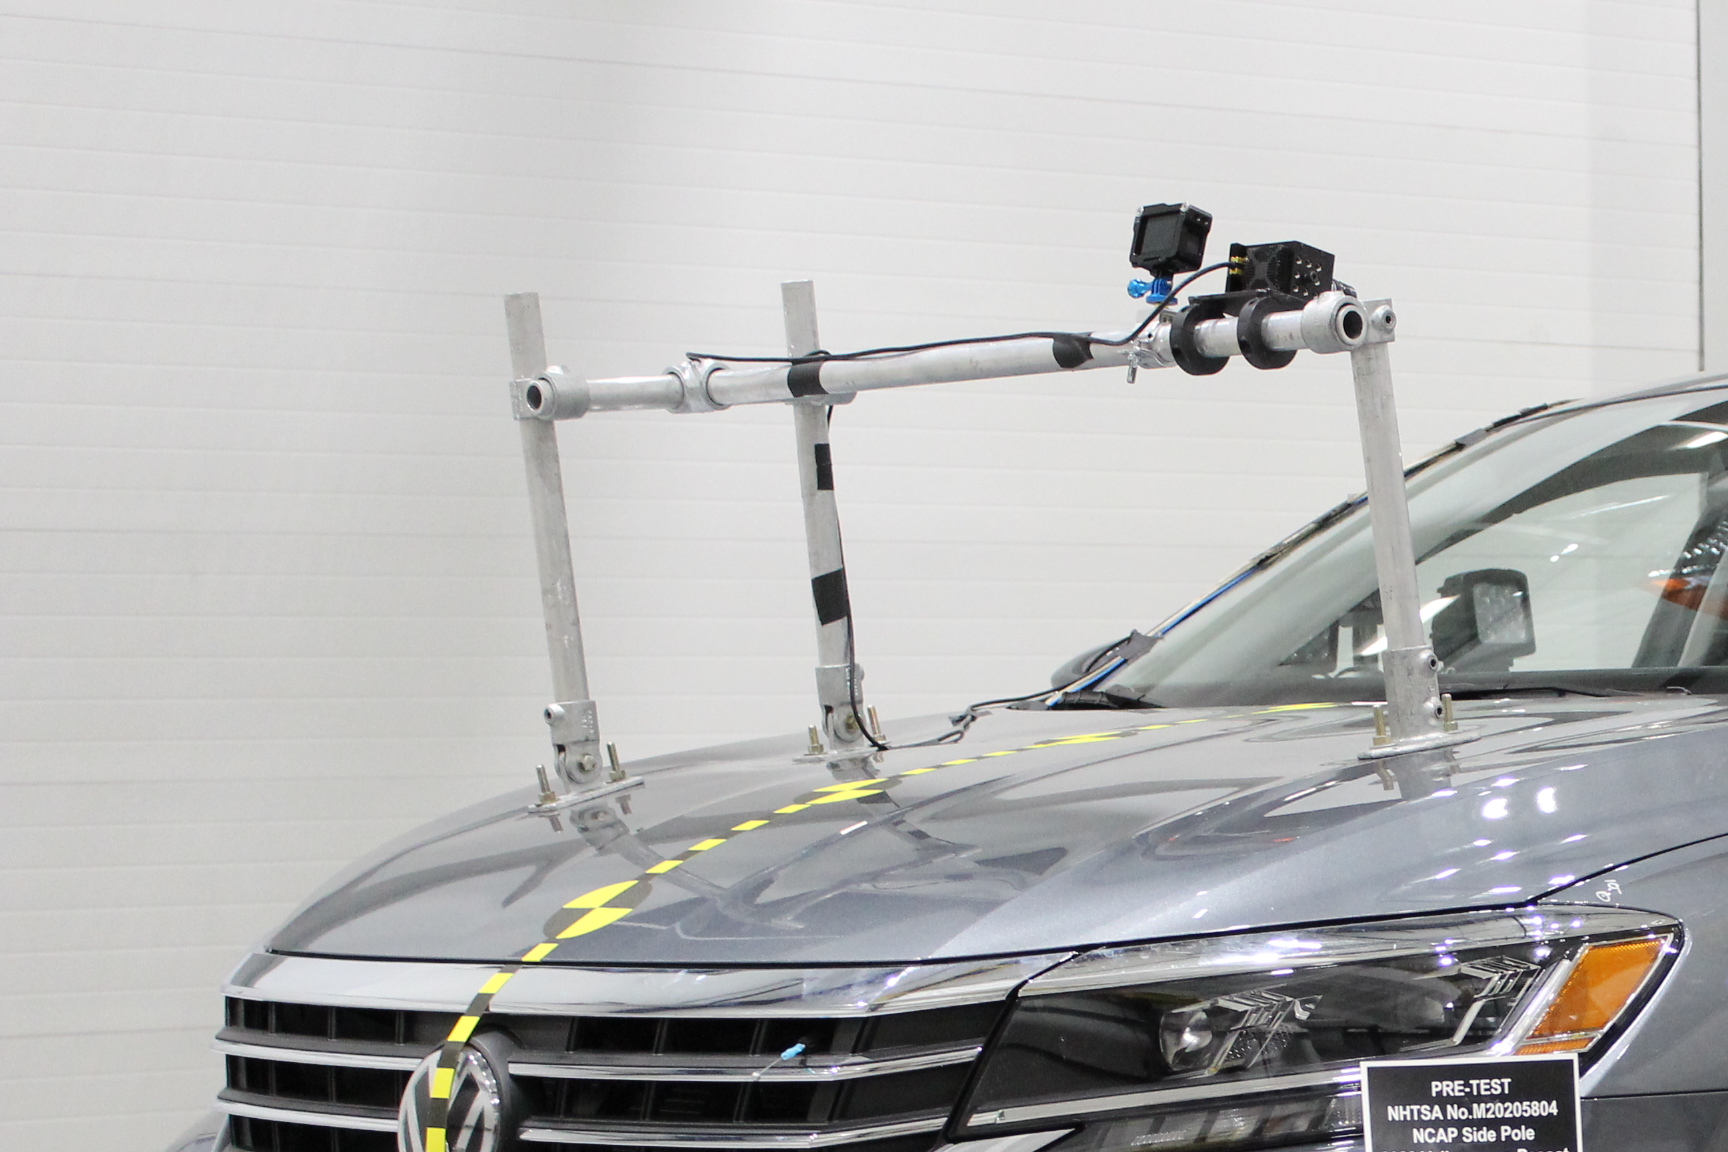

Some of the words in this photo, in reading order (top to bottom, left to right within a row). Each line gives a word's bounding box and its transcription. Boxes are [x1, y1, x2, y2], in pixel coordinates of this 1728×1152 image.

[1431, 1078, 1511, 1097] PRE-TEST
[1387, 1105, 1443, 1121] NHTSA
[1446, 1100, 1558, 1120] No.M20205804
[1412, 1127, 1458, 1144] NCAP
[1461, 1127, 1497, 1143] Side
[1500, 1125, 1535, 1141] Pole
